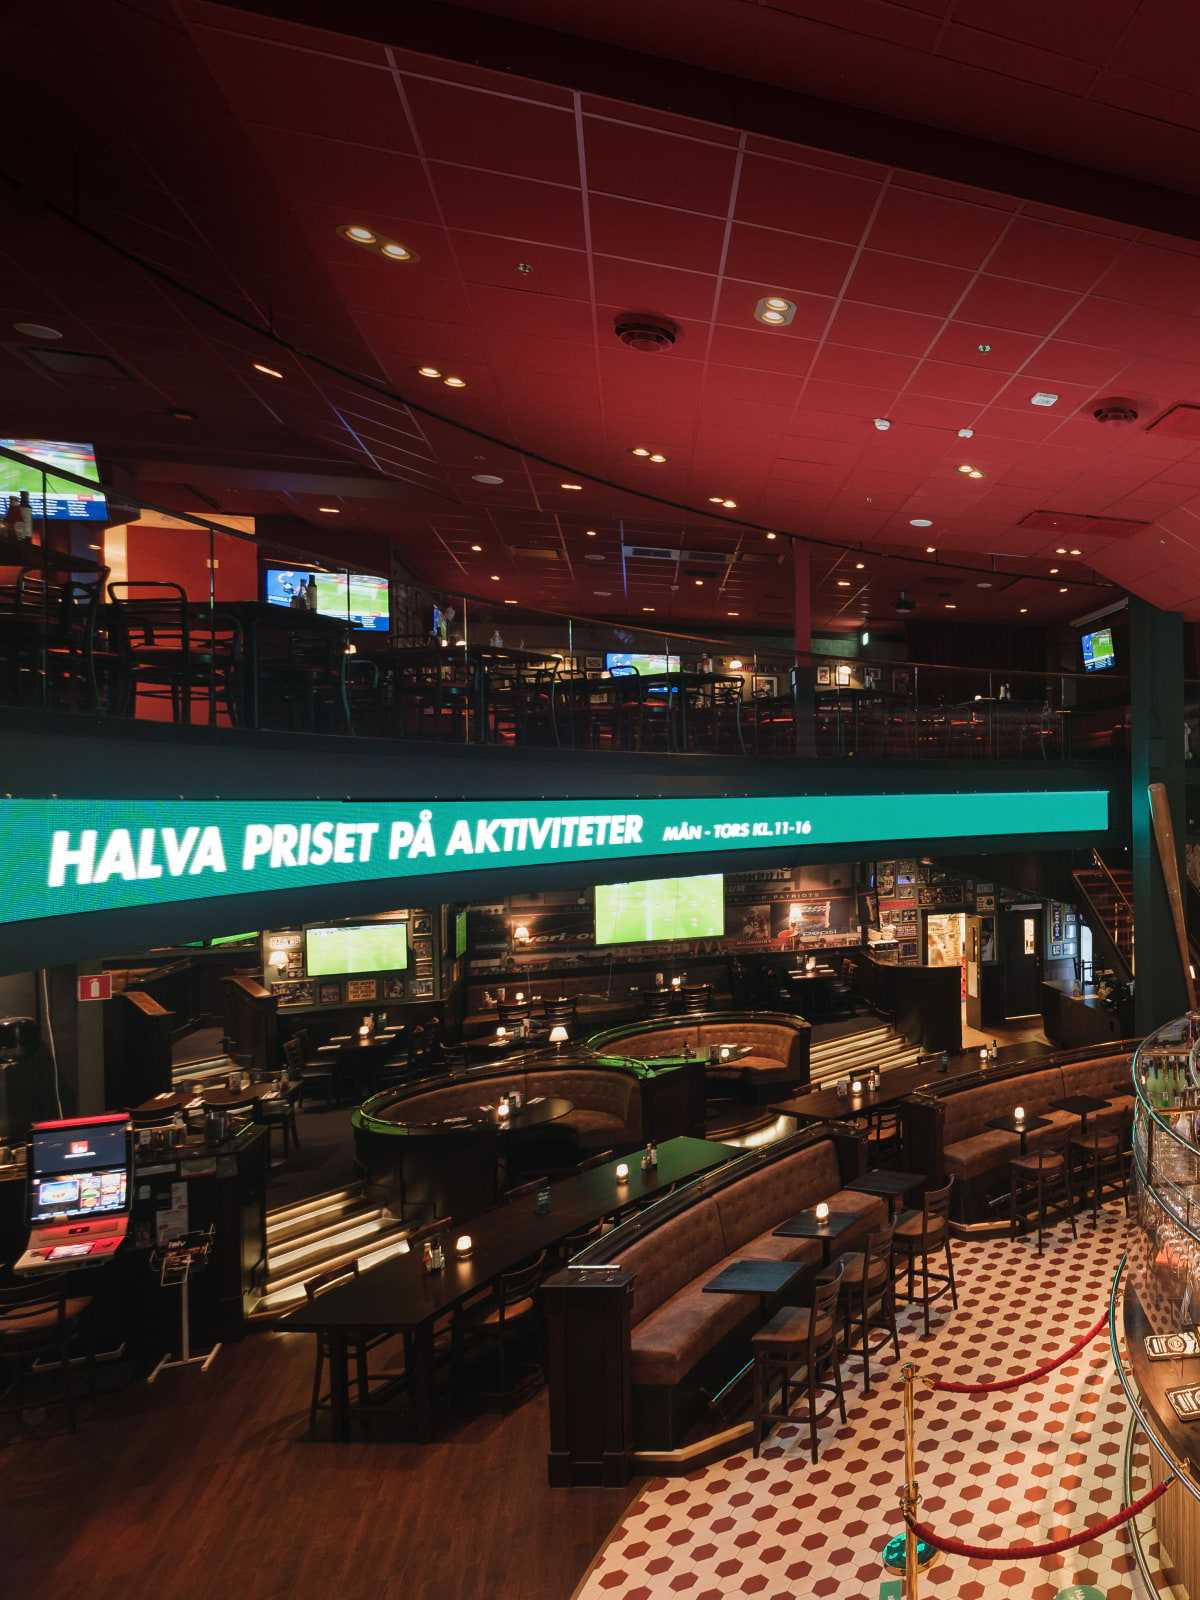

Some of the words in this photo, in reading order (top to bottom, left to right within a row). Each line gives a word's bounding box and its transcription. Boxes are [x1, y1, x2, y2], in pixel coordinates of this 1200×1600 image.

[48, 826, 228, 888] HALVA
[242, 822, 378, 871] PRISET
[389, 809, 436, 860] PÅ
[445, 814, 643, 856] AKTIVITETER
[663, 822, 701, 841] MÅN
[714, 822, 750, 839] TORS
